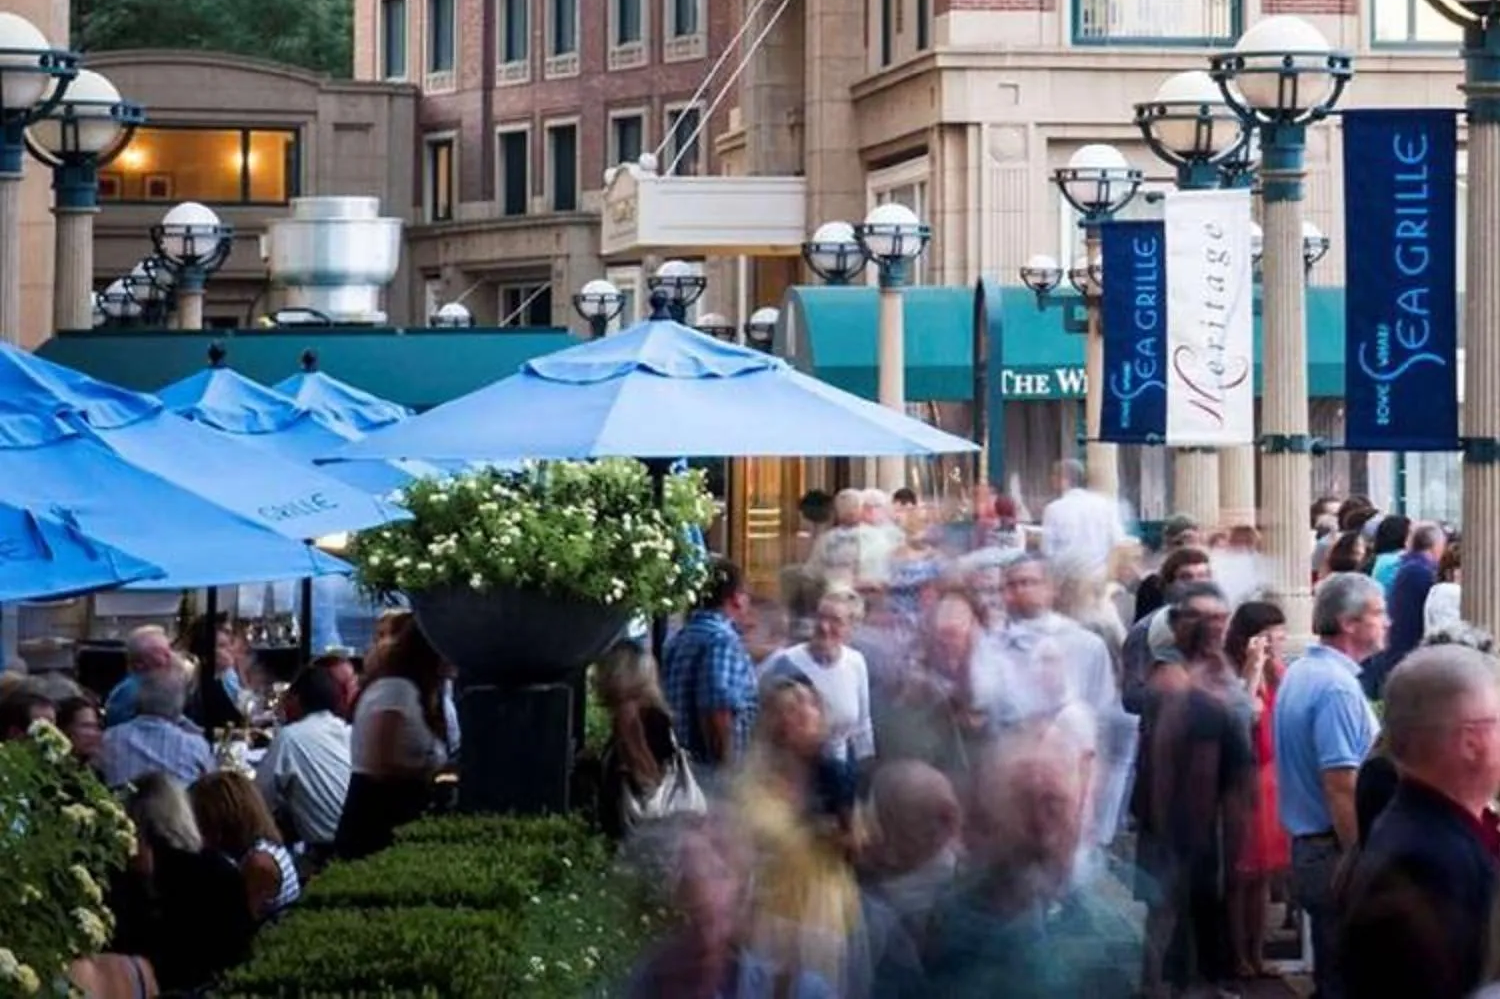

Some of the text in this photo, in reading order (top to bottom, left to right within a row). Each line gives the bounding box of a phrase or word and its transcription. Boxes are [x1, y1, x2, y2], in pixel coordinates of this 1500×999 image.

[1110, 236, 1167, 399] SEA GRILLE
[1358, 133, 1446, 381] SEA GRILLE
[1056, 368, 1088, 394] W
